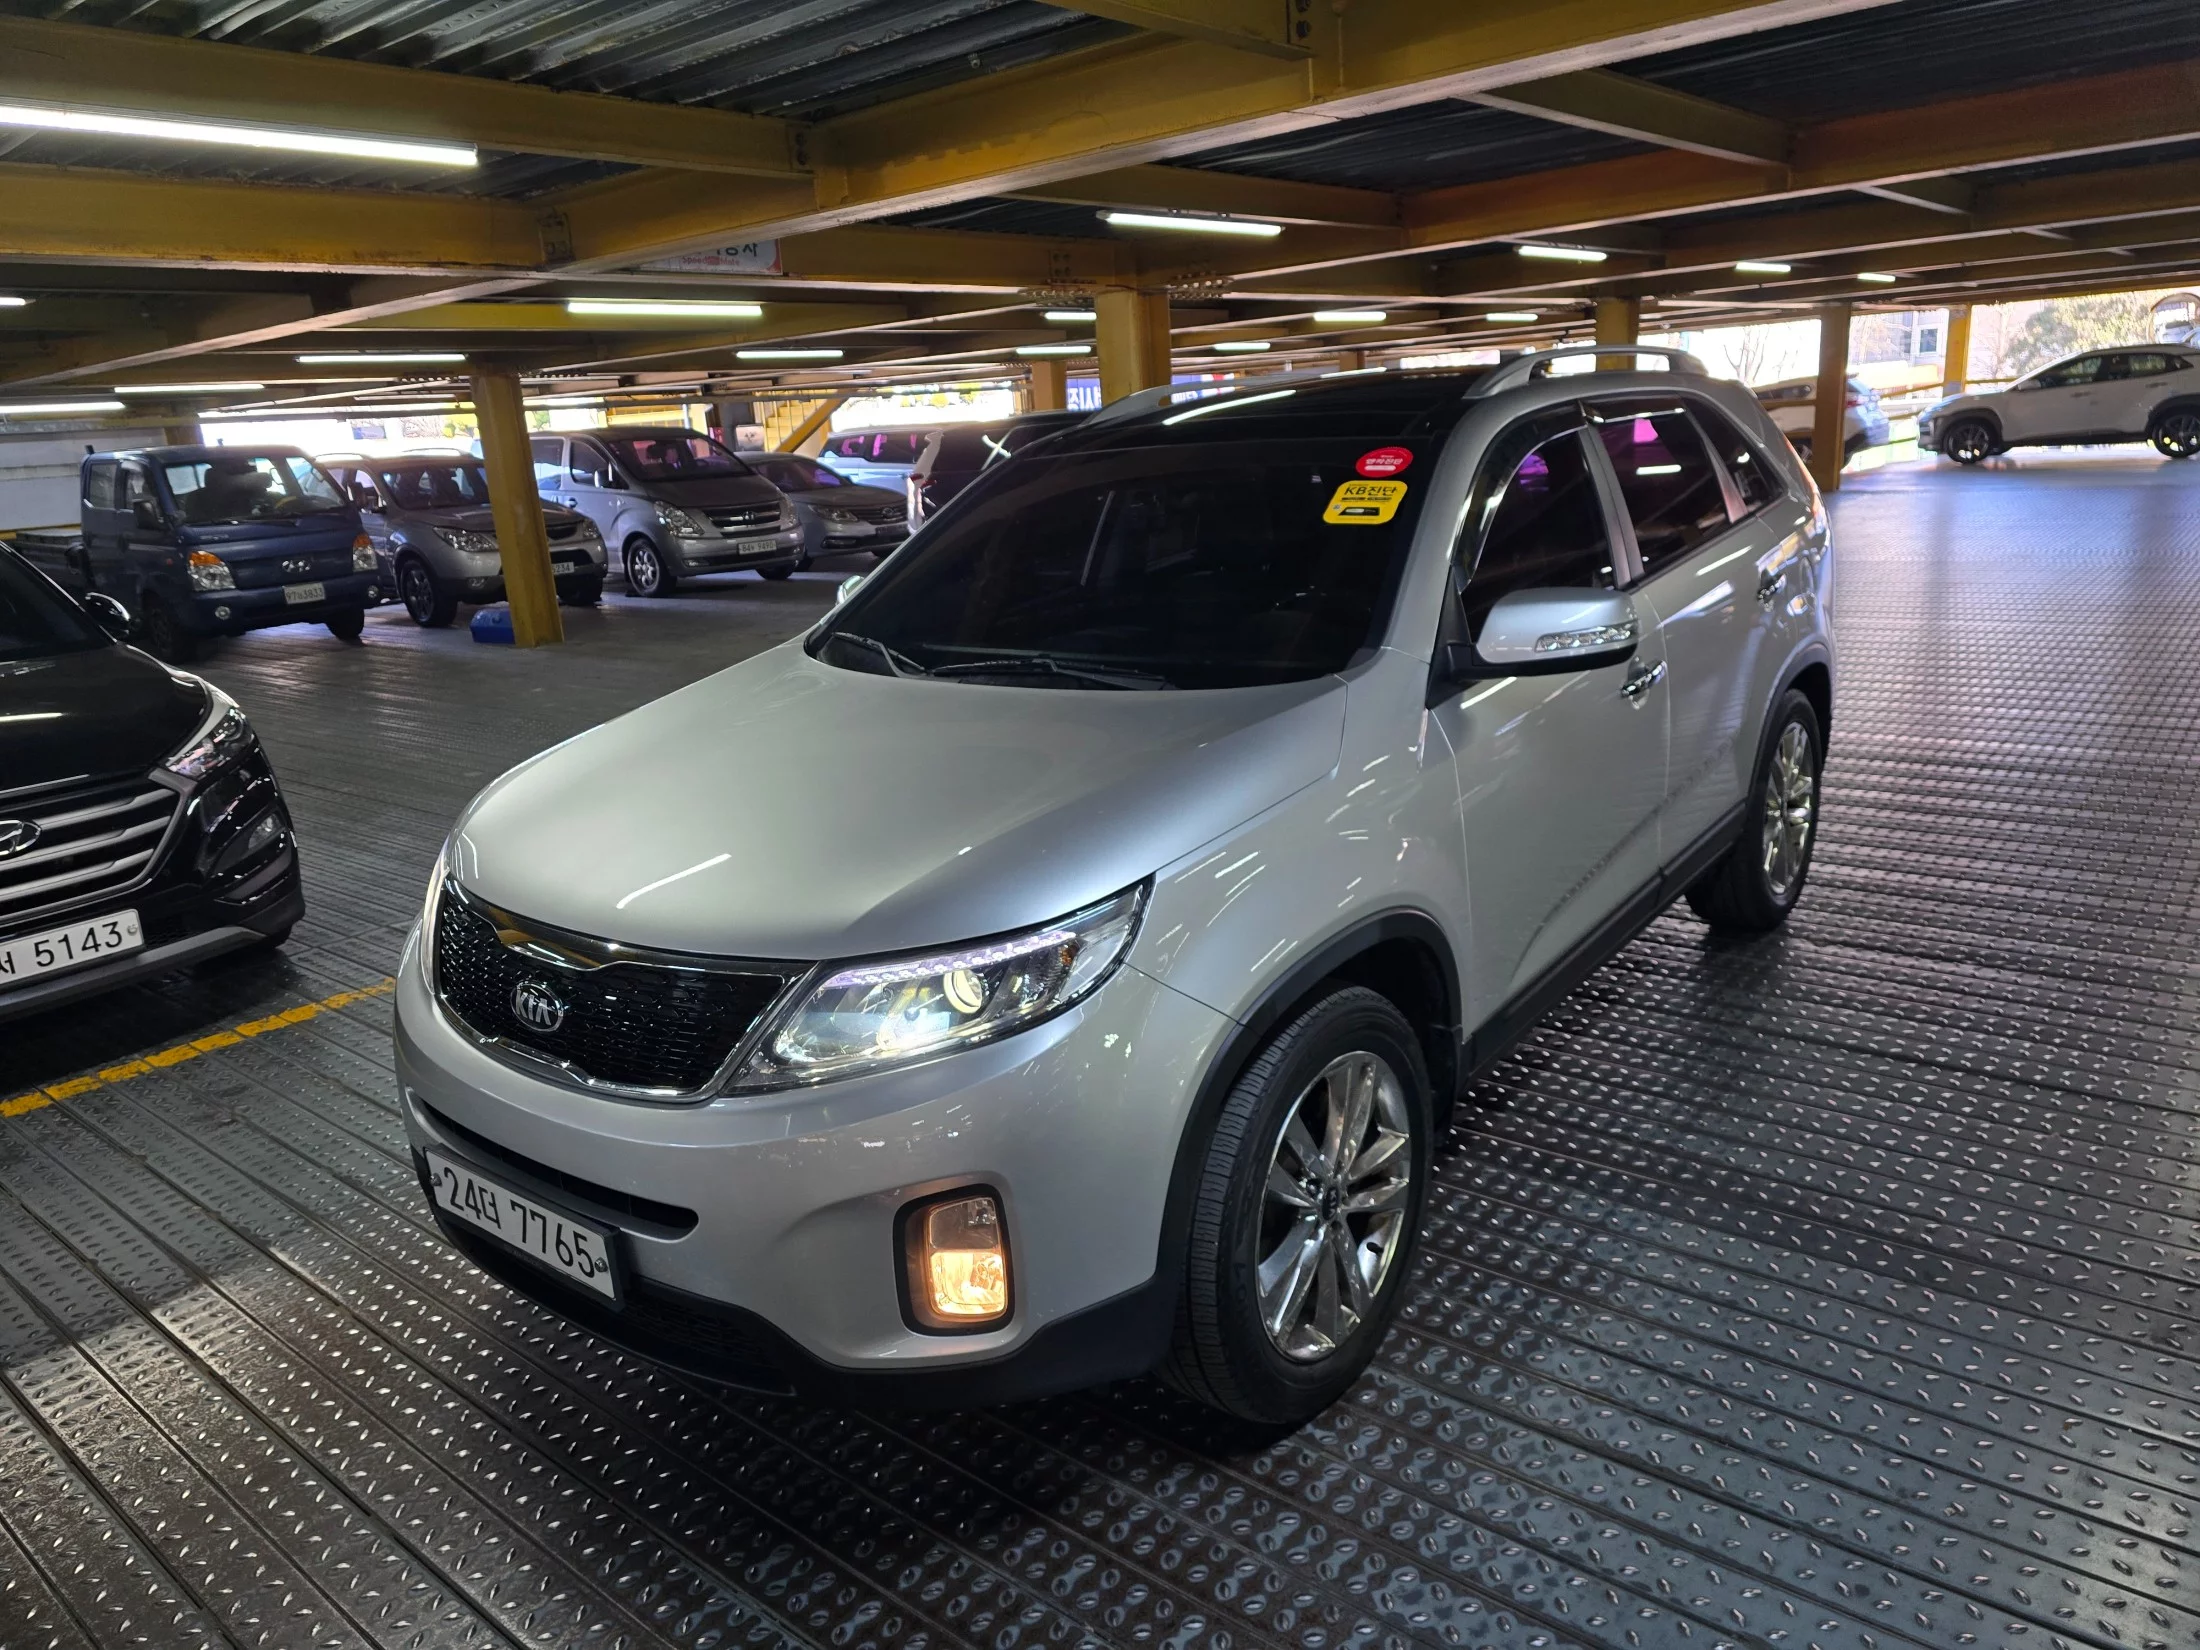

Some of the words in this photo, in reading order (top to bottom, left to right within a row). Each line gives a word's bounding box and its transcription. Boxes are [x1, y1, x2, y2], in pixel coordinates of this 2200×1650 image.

[1344, 486, 1398, 497] KB진단
[34, 921, 122, 967] 5143
[515, 989, 552, 1026] KIA
[444, 1166, 502, 1230] 24더
[509, 1198, 595, 1279] 7765
